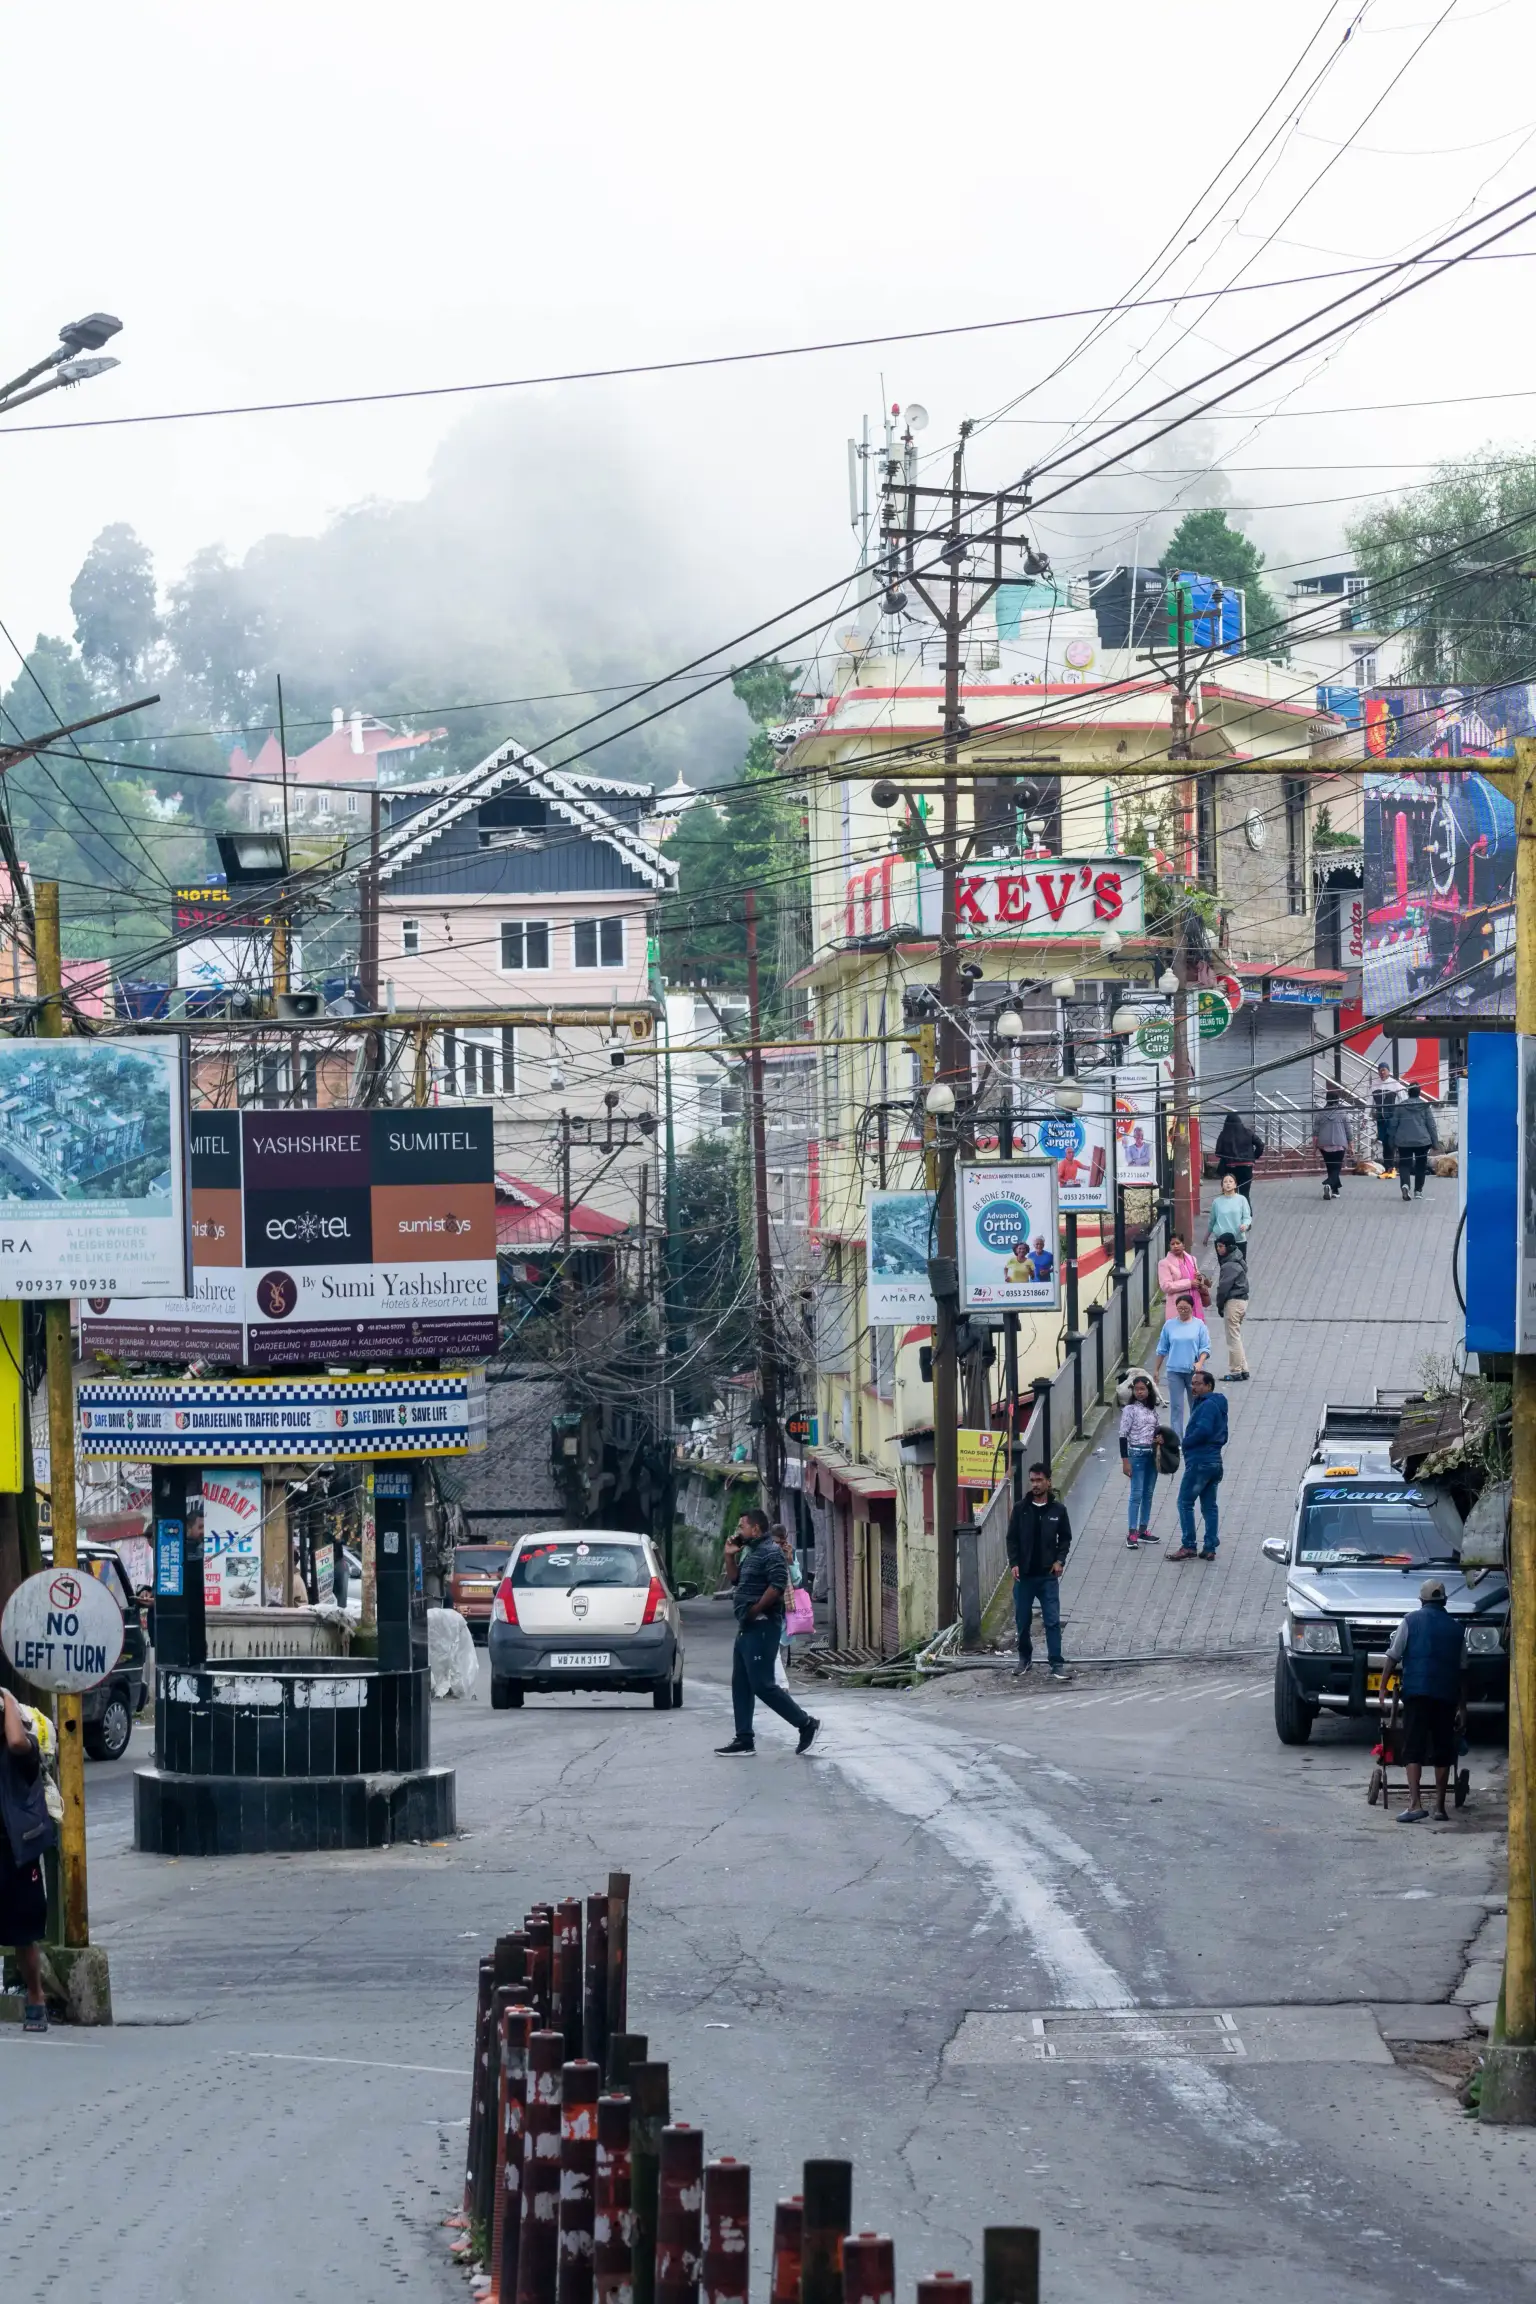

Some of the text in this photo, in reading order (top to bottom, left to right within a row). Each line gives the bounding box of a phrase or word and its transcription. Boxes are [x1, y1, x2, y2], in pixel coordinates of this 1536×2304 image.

[177, 889, 231, 901] HOTEL
[955, 866, 1123, 923] KEV'S
[1349, 901, 1363, 958] Bata
[1144, 1034, 1170, 1044] Lung
[1146, 1043, 1169, 1052] Care
[252, 1135, 361, 1154] YASHSHREE
[389, 1132, 478, 1151] SUMITEL
[972, 1191, 1032, 1212] BE BONE STRONG!
[986, 1212, 1019, 1220] Advanced
[67, 1226, 147, 1236] A LIFE WHERE
[984, 1220, 1022, 1232] Ortho
[70, 1240, 145, 1250] NEIGHBOURS
[988, 1233, 1019, 1244] Care
[59, 1252, 156, 1263] ARE LIKE FAMILY
[16, 1279, 117, 1292] 90937 90938
[302, 1272, 487, 1298] By Sumi Yashshree
[881, 1294, 926, 1303] AMARA
[1006, 1289, 1049, 1297] 0353 2518667
[381, 1299, 410, 1308] Hotels
[412, 1298, 419, 1308] &
[421, 1297, 449, 1308] Resort
[85, 1337, 114, 1345] DARJEELING
[151, 1339, 180, 1348] KALIMPONG
[215, 1342, 240, 1351] LACHUNG
[254, 1333, 494, 1351] DARJEELING BIJANBARI KALIMPONG GANGTOK LACHUNG
[118, 1349, 139, 1357] PELLING
[208, 1352, 231, 1361] KOLKATA
[268, 1345, 480, 1361] LACHEN PELLING MUSSOORIE SILIGURI KOLKATA
[94, 1405, 447, 1428] SAFE DRIVE SAVE LIFE DARJEELING TRAFFIC POLICE SAFE DRIVE SAVE LIFE
[376, 1484, 401, 1494] SAVE
[161, 1545, 169, 1569] SAVE
[170, 1541, 179, 1560] SAFE
[47, 1612, 79, 1636] NO
[15, 1641, 106, 1673] LEFT TURN
